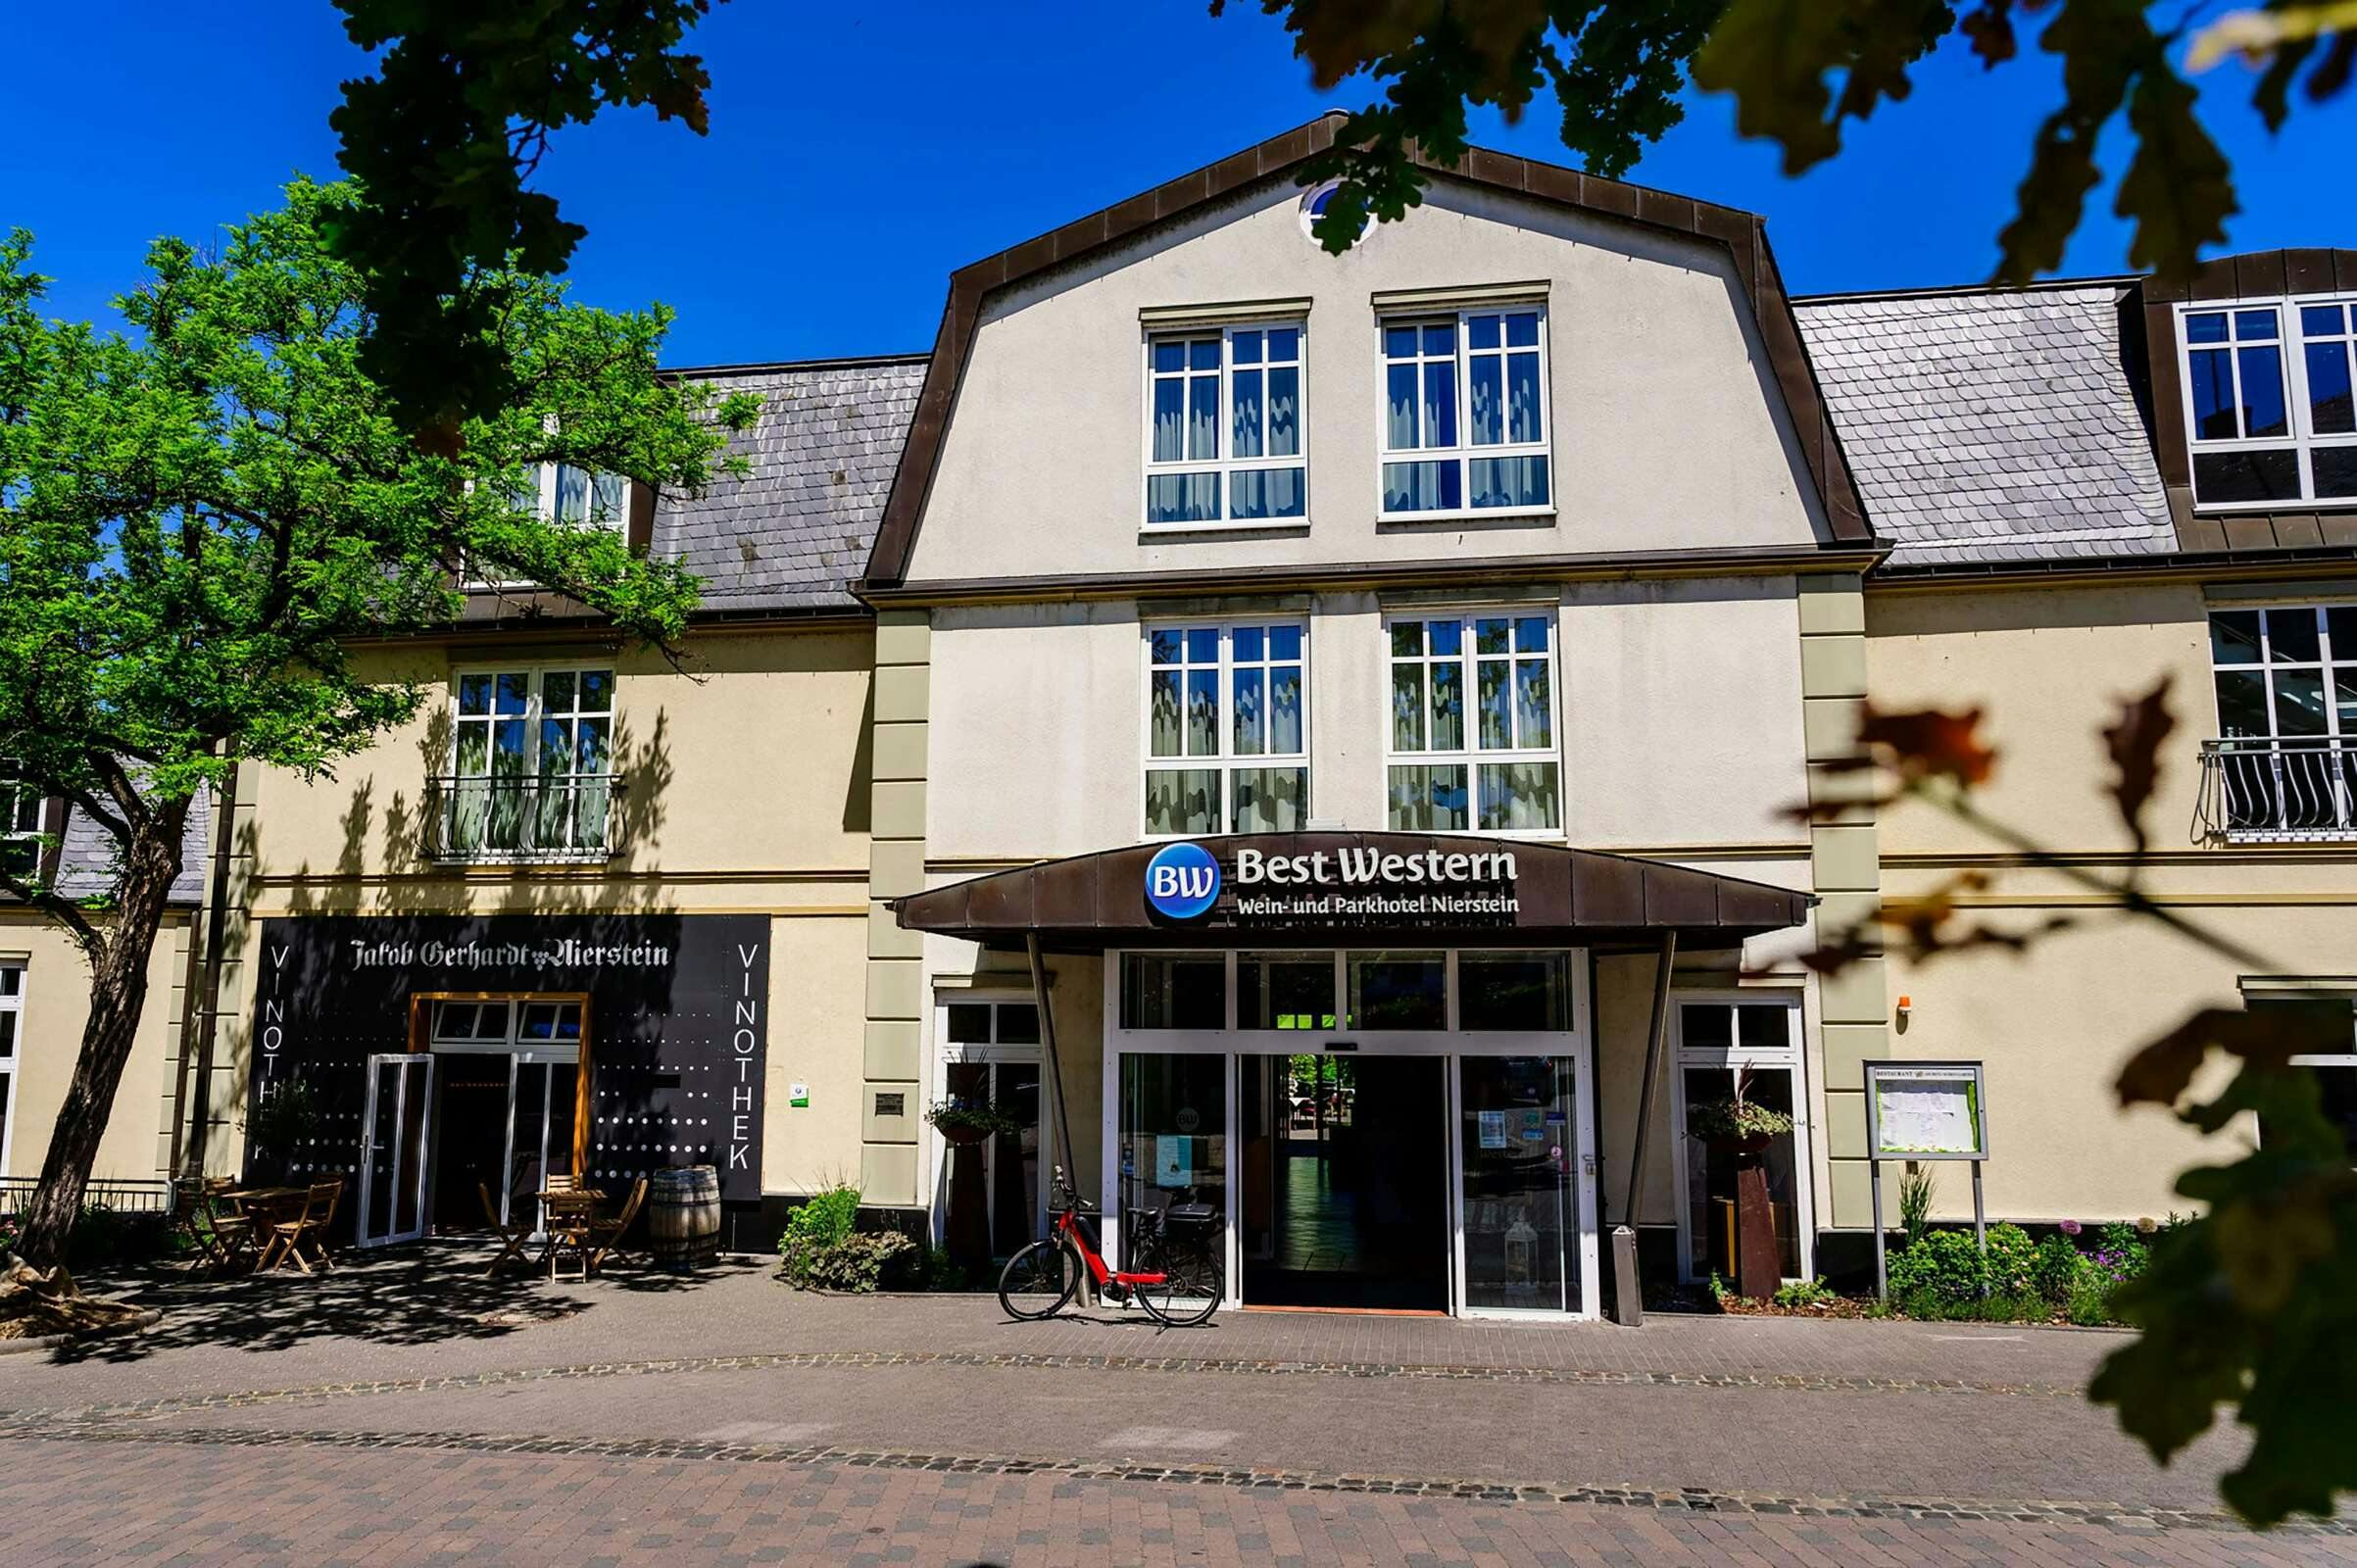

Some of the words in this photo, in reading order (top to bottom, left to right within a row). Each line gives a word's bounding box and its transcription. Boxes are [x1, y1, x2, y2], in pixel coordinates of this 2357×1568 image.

[1152, 865, 1213, 899] BW
[1237, 848, 1330, 884] Best
[1337, 846, 1519, 884] Western
[1237, 898, 1289, 914] Wein-
[1293, 898, 1331, 914] und
[1335, 897, 1427, 913] Parkhotel
[1431, 896, 1520, 912] Nierstein
[350, 939, 414, 971] Jakob
[420, 939, 530, 971] Gerhardt
[546, 938, 669, 967] Nierstein
[254, 945, 289, 1160] VINOTH
[729, 944, 759, 1170] VINOTHEK
